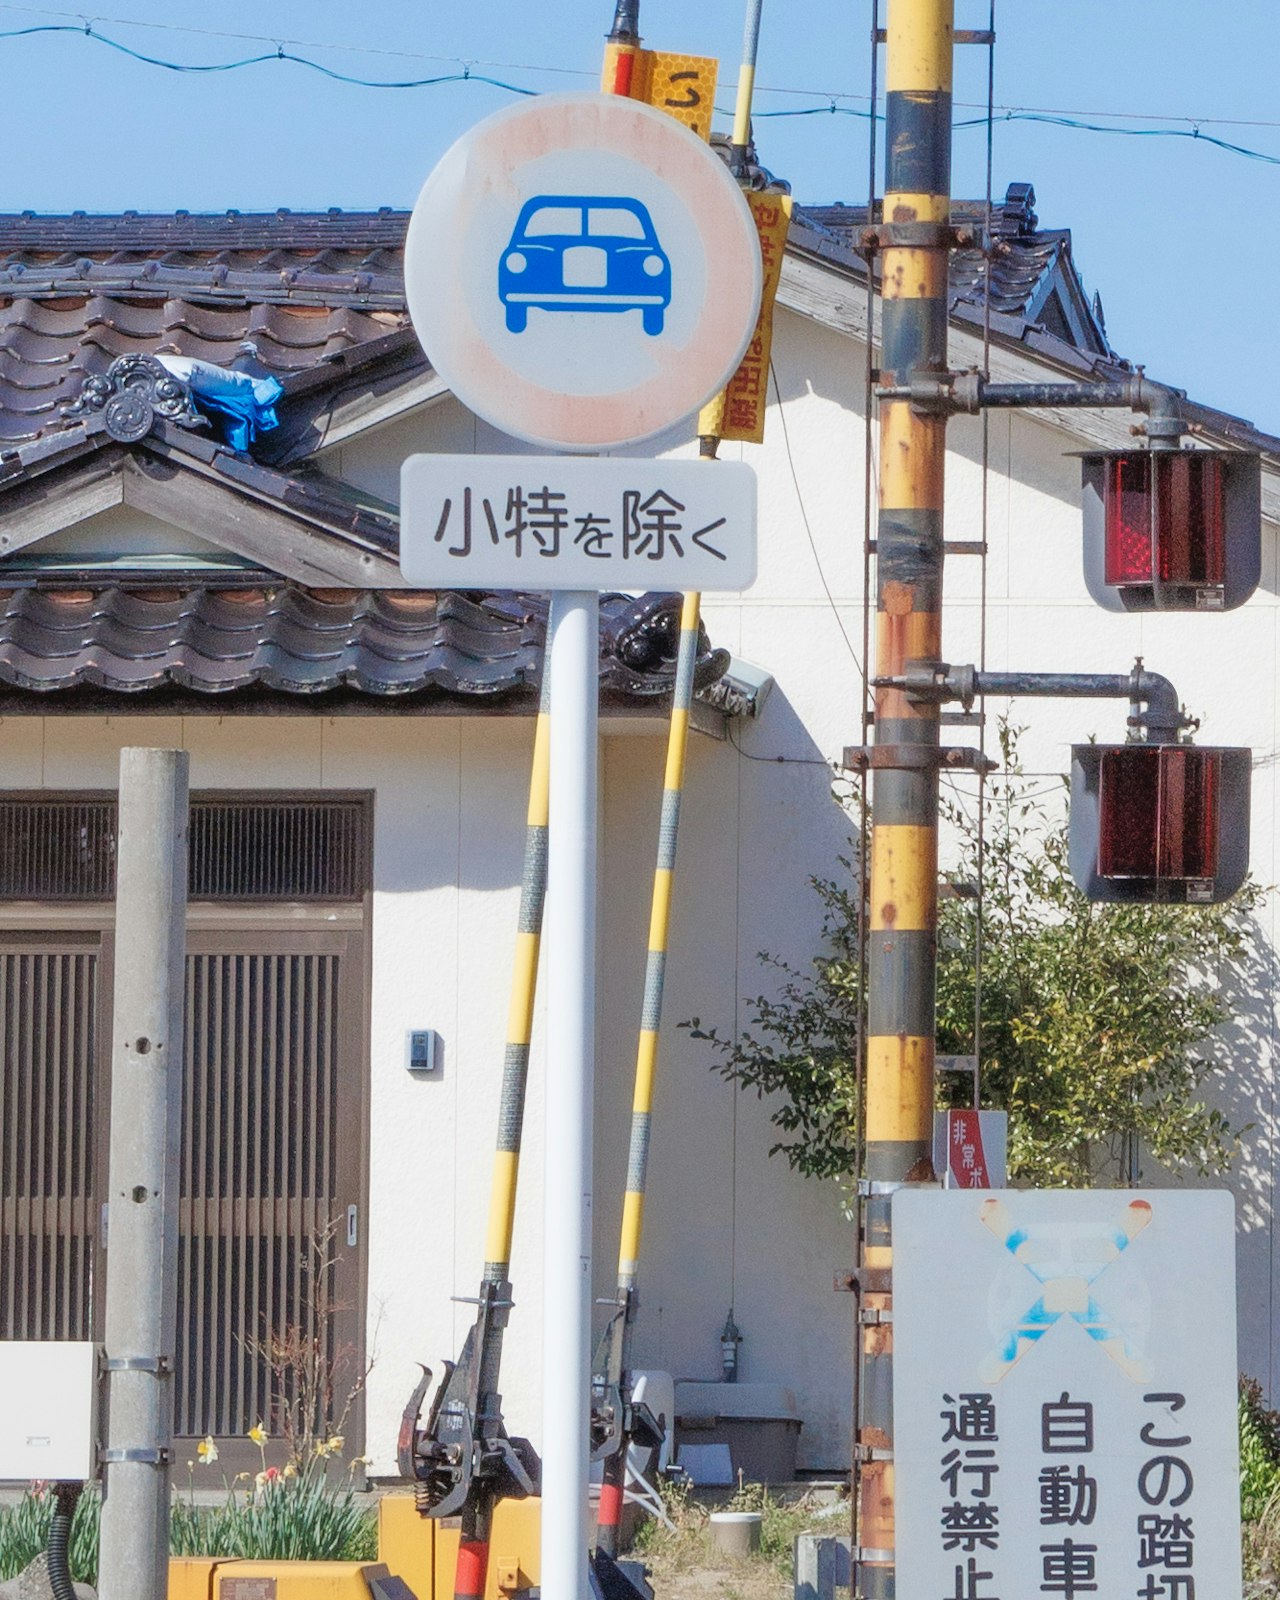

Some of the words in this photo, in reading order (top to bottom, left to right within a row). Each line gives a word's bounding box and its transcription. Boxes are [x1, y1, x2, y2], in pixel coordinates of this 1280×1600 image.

[434, 485, 727, 561] 小特を除く
[953, 1119, 983, 1189] 非常ボ
